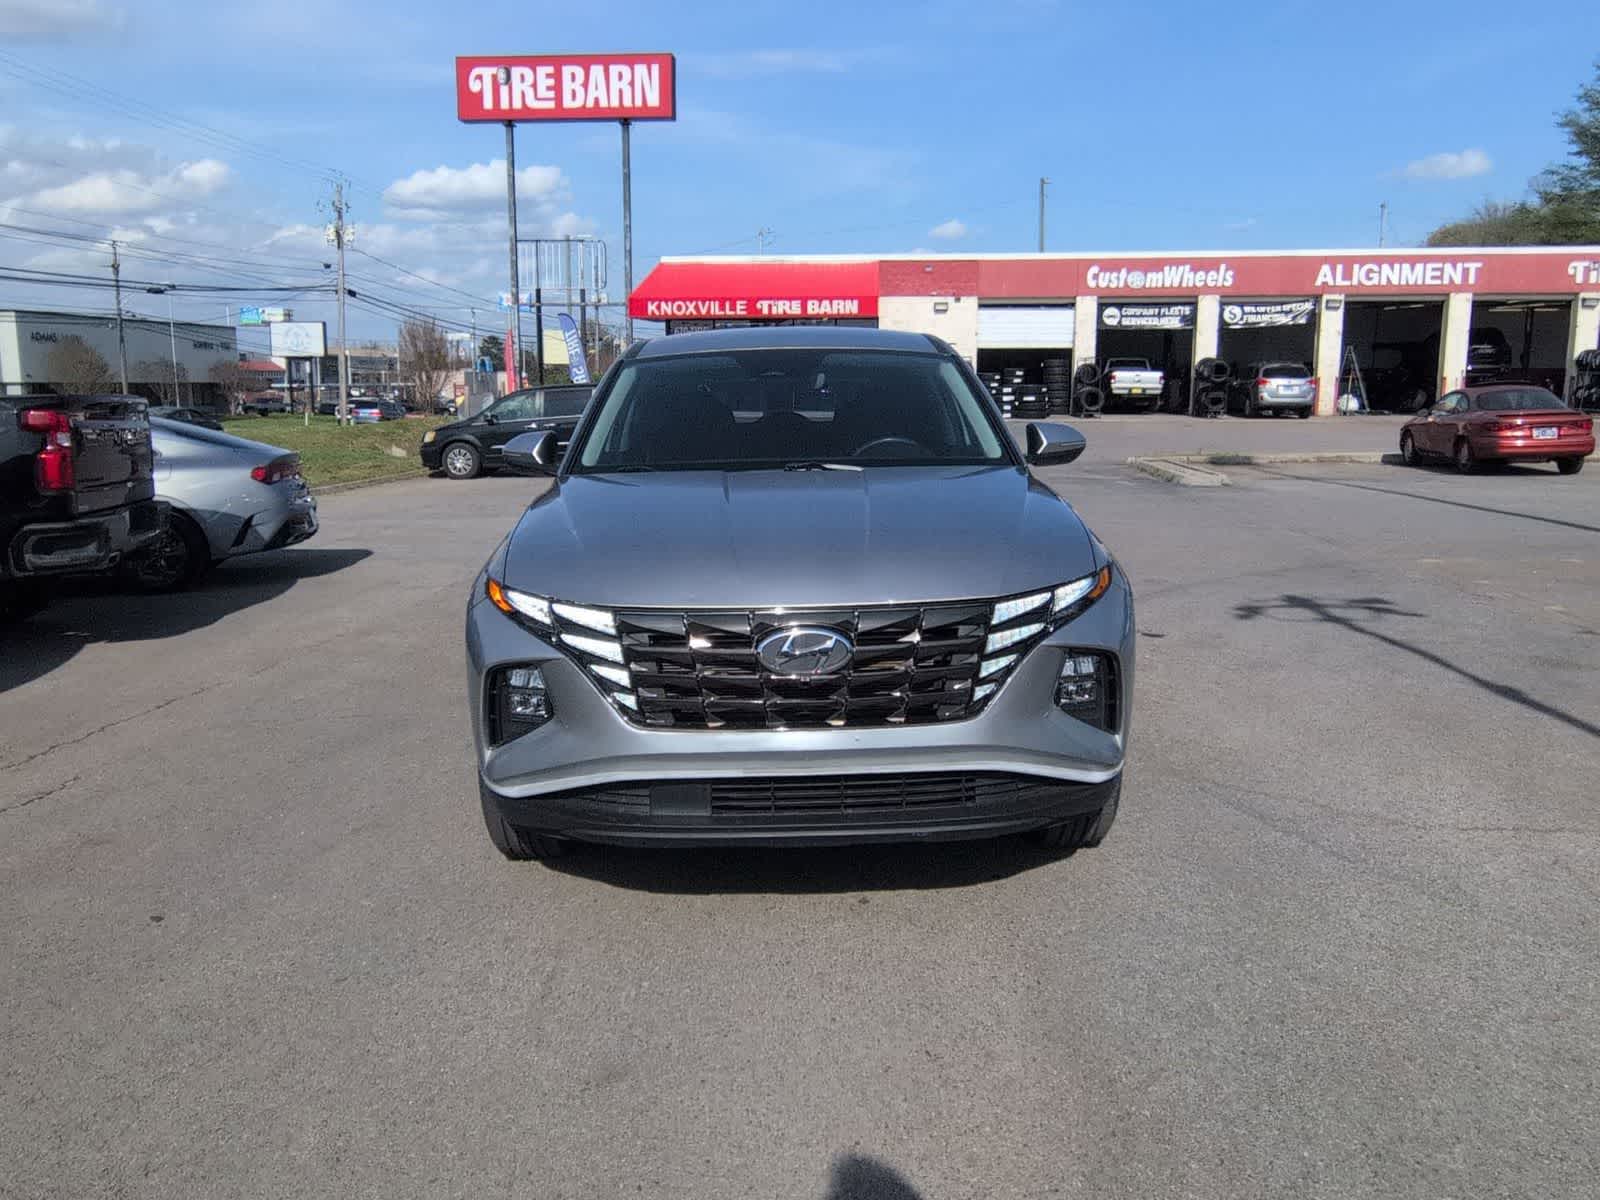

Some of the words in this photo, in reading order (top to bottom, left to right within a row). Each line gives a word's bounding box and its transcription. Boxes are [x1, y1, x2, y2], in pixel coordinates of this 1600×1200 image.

[562, 63, 660, 109] BARN
[1315, 262, 1483, 287] ALIGNMENT
[647, 300, 748, 315] KNOXVILLE
[807, 299, 859, 315] BARN
